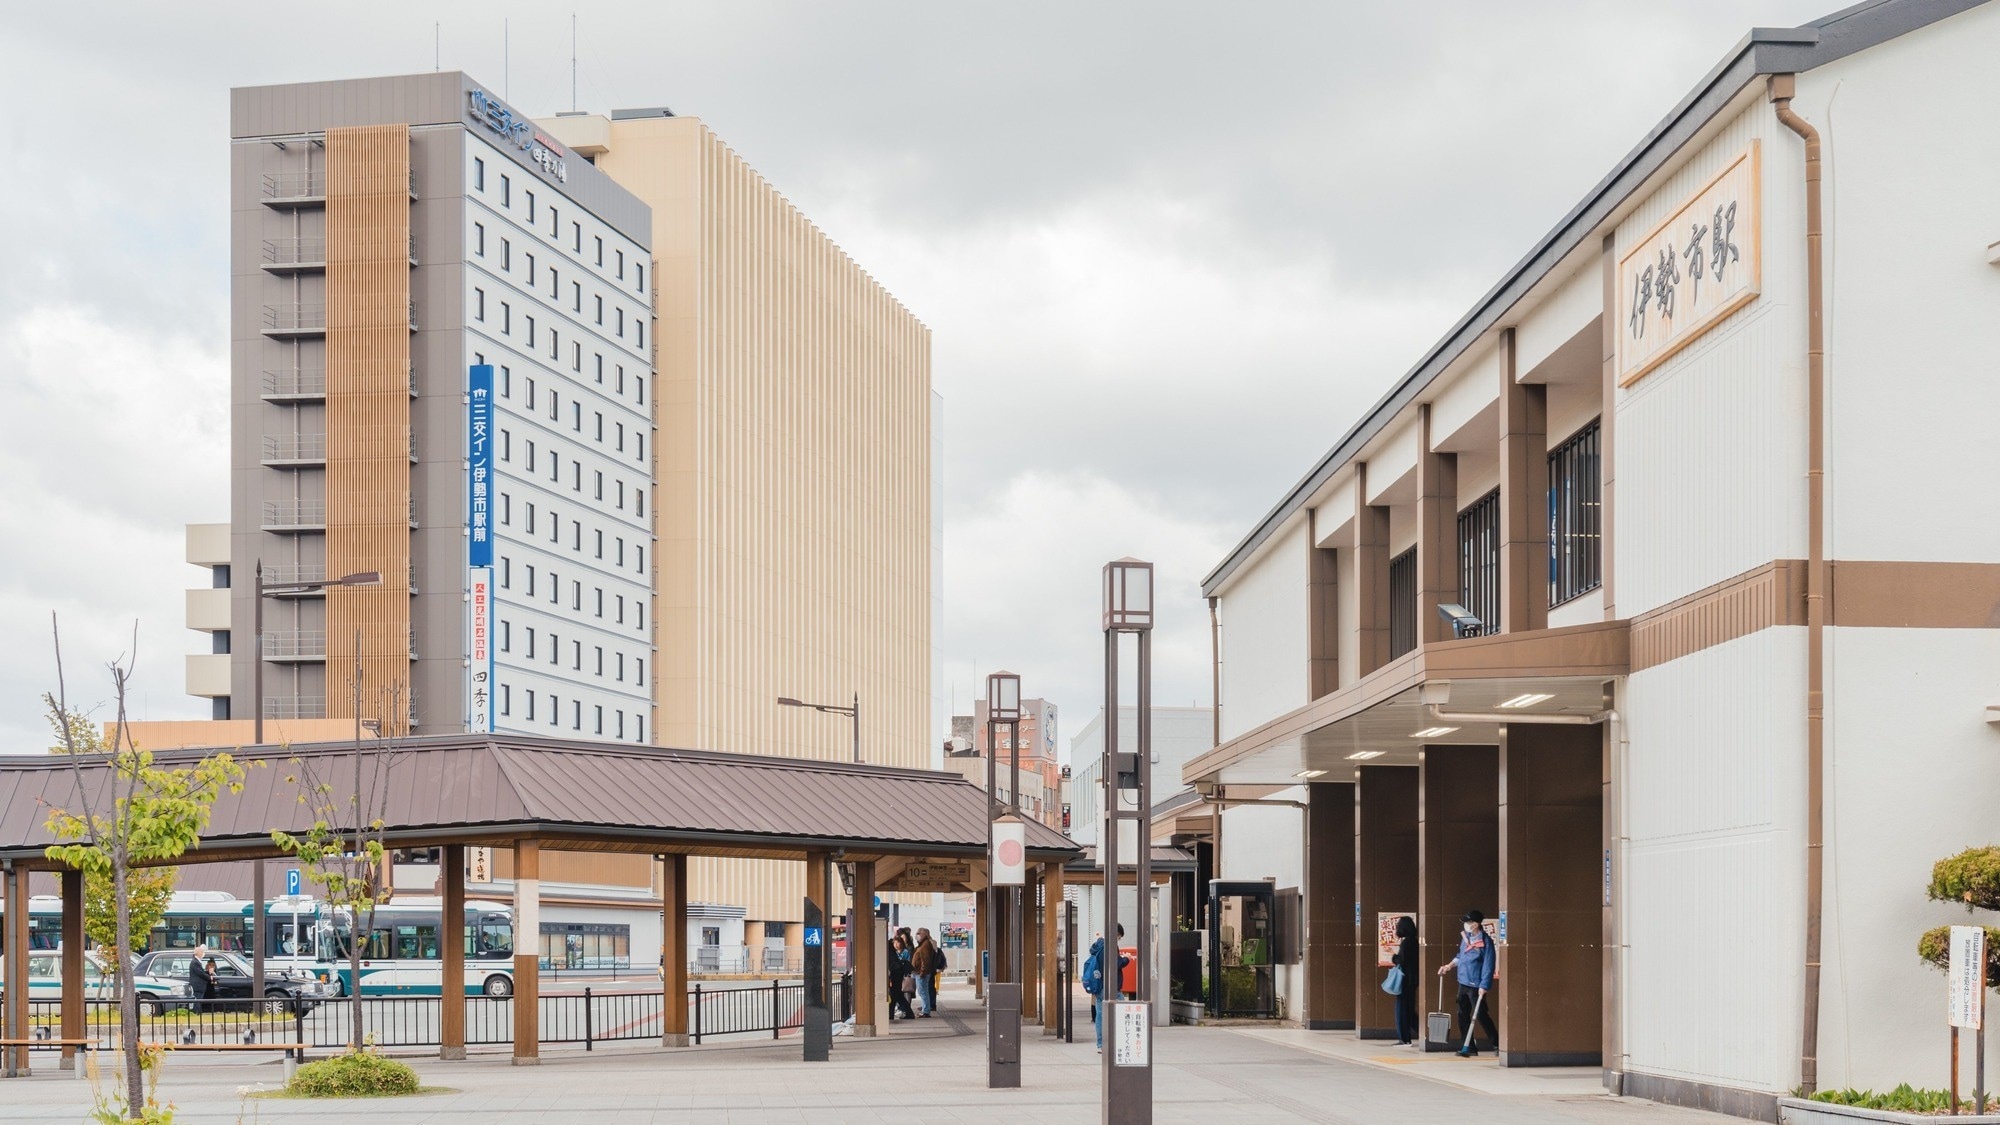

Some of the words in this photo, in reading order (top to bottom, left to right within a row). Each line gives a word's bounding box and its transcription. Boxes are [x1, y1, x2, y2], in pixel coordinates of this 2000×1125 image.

[1628, 199, 1739, 340] 伊勢市駅
[473, 404, 487, 542] 三交イン伊勢市駅前
[473, 671, 488, 733] 四季乃
[290, 872, 298, 894] P
[909, 867, 920, 877] 10
